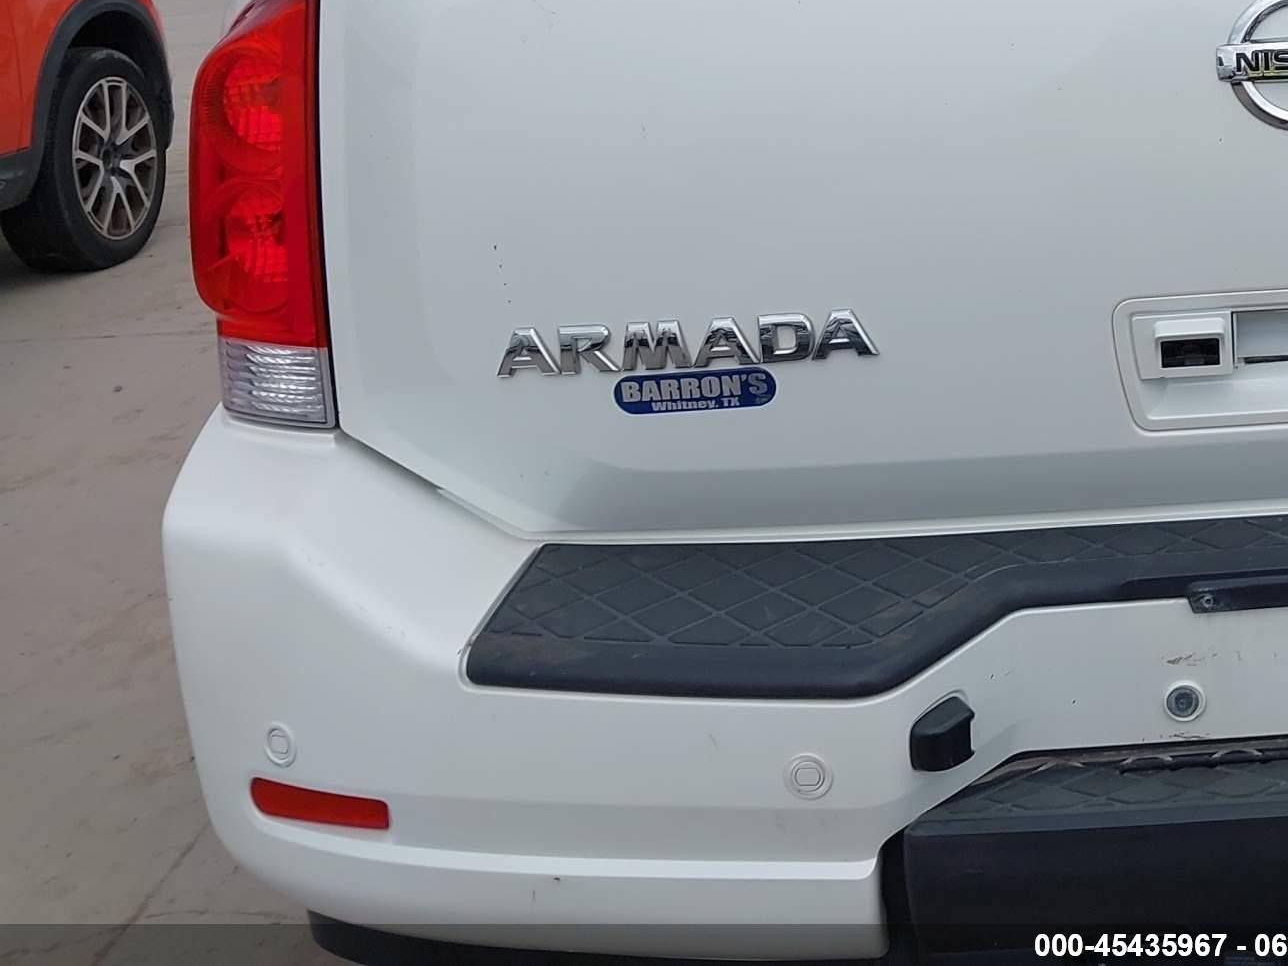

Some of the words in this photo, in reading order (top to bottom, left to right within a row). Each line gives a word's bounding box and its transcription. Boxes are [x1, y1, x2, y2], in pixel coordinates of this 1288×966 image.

[496, 307, 881, 379] ARMADA
[620, 373, 769, 403] BARRON'S
[721, 396, 741, 408] TX
